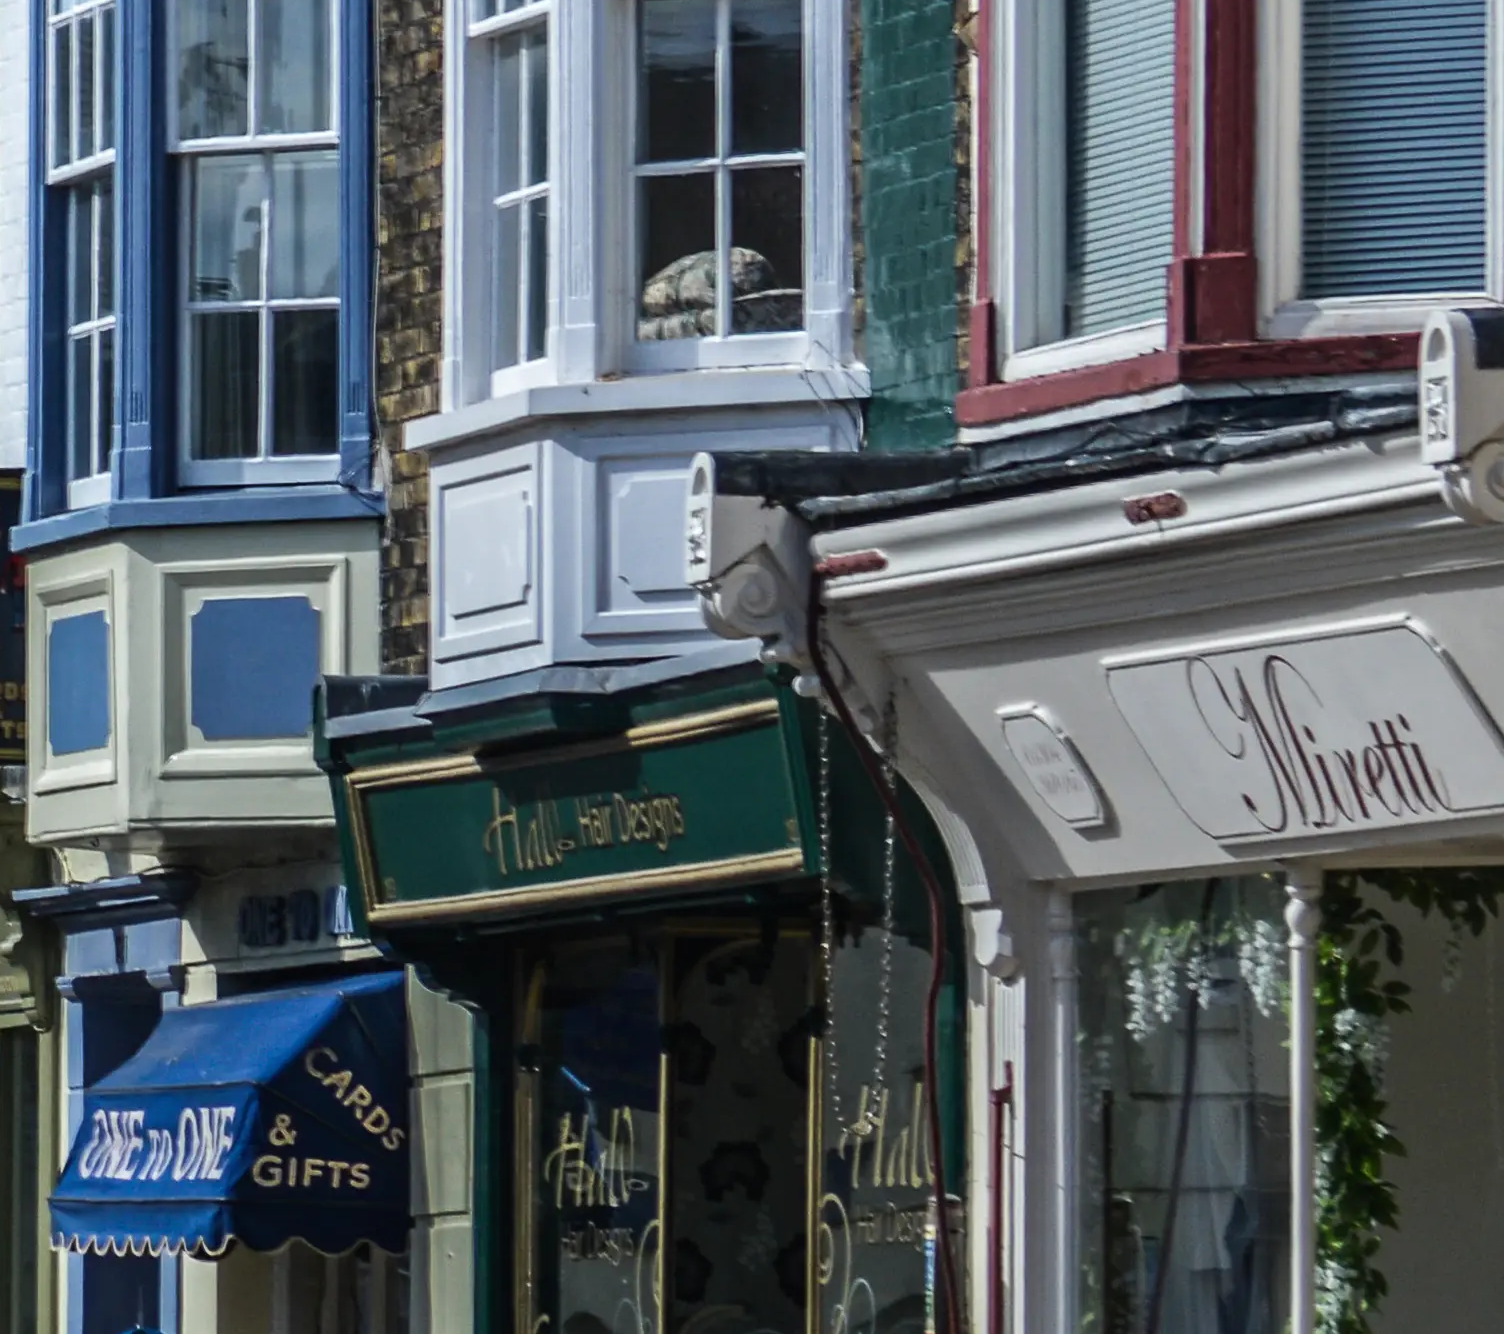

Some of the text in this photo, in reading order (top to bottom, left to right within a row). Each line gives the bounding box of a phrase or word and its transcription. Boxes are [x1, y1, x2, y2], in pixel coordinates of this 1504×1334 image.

[1186, 654, 1454, 833] Miretti
[576, 794, 612, 847] Hair
[613, 783, 684, 852] Designs
[268, 1113, 298, 1147] &
[304, 1046, 406, 1151] CARDS
[78, 1107, 145, 1181] ONE
[171, 1106, 237, 1181] ONE
[251, 1154, 371, 1190] GIFTS
